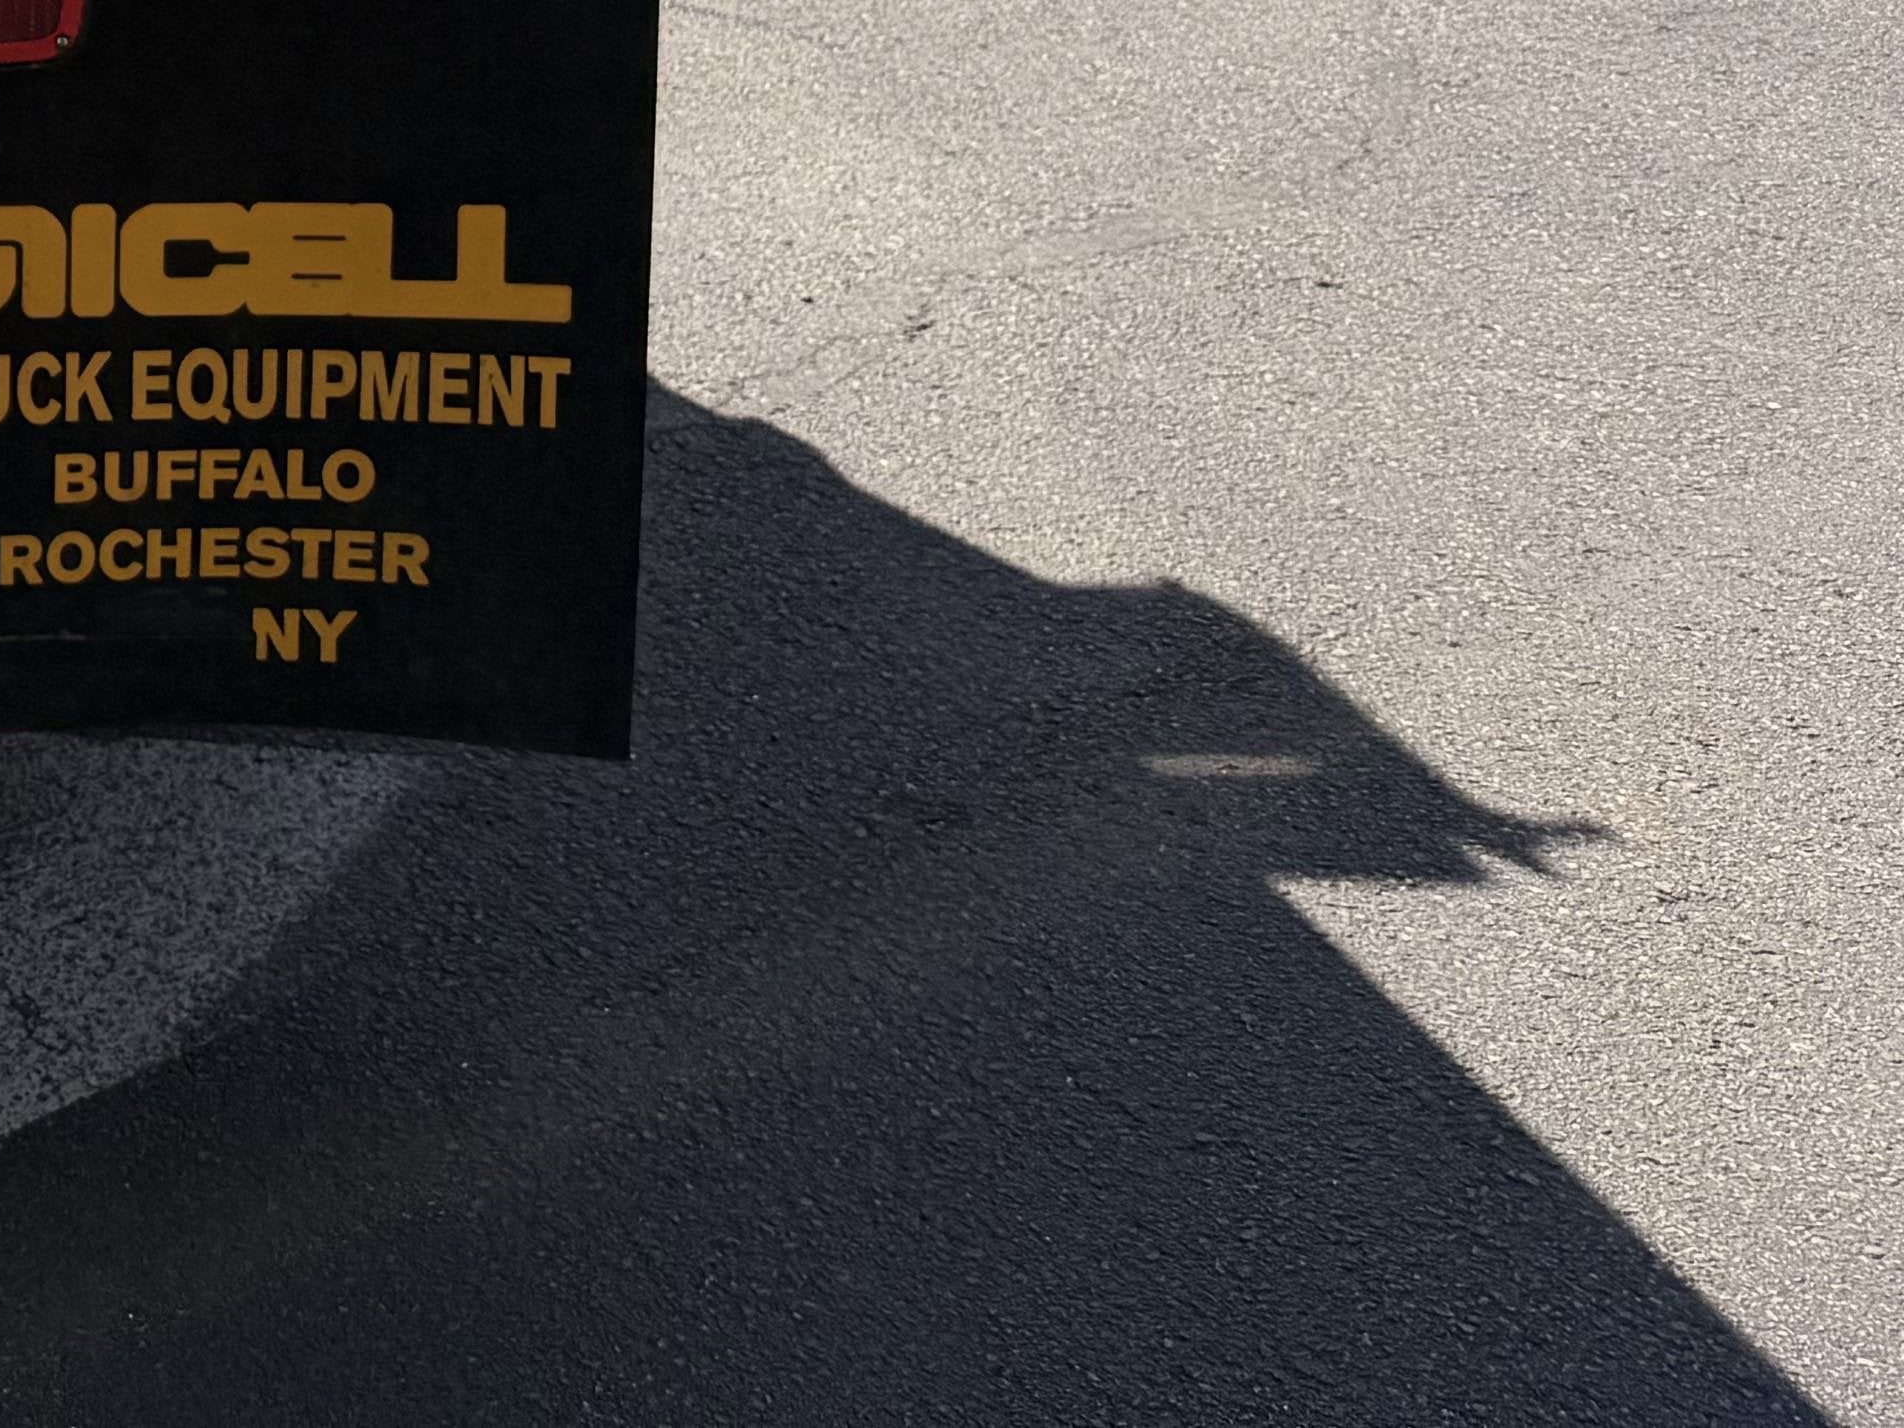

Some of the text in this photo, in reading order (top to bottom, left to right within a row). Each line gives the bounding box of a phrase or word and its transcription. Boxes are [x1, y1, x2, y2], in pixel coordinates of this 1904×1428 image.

[132, 347, 571, 429] EQUIPMENT
[53, 448, 376, 504] BUFFALO
[252, 607, 358, 664] NY
